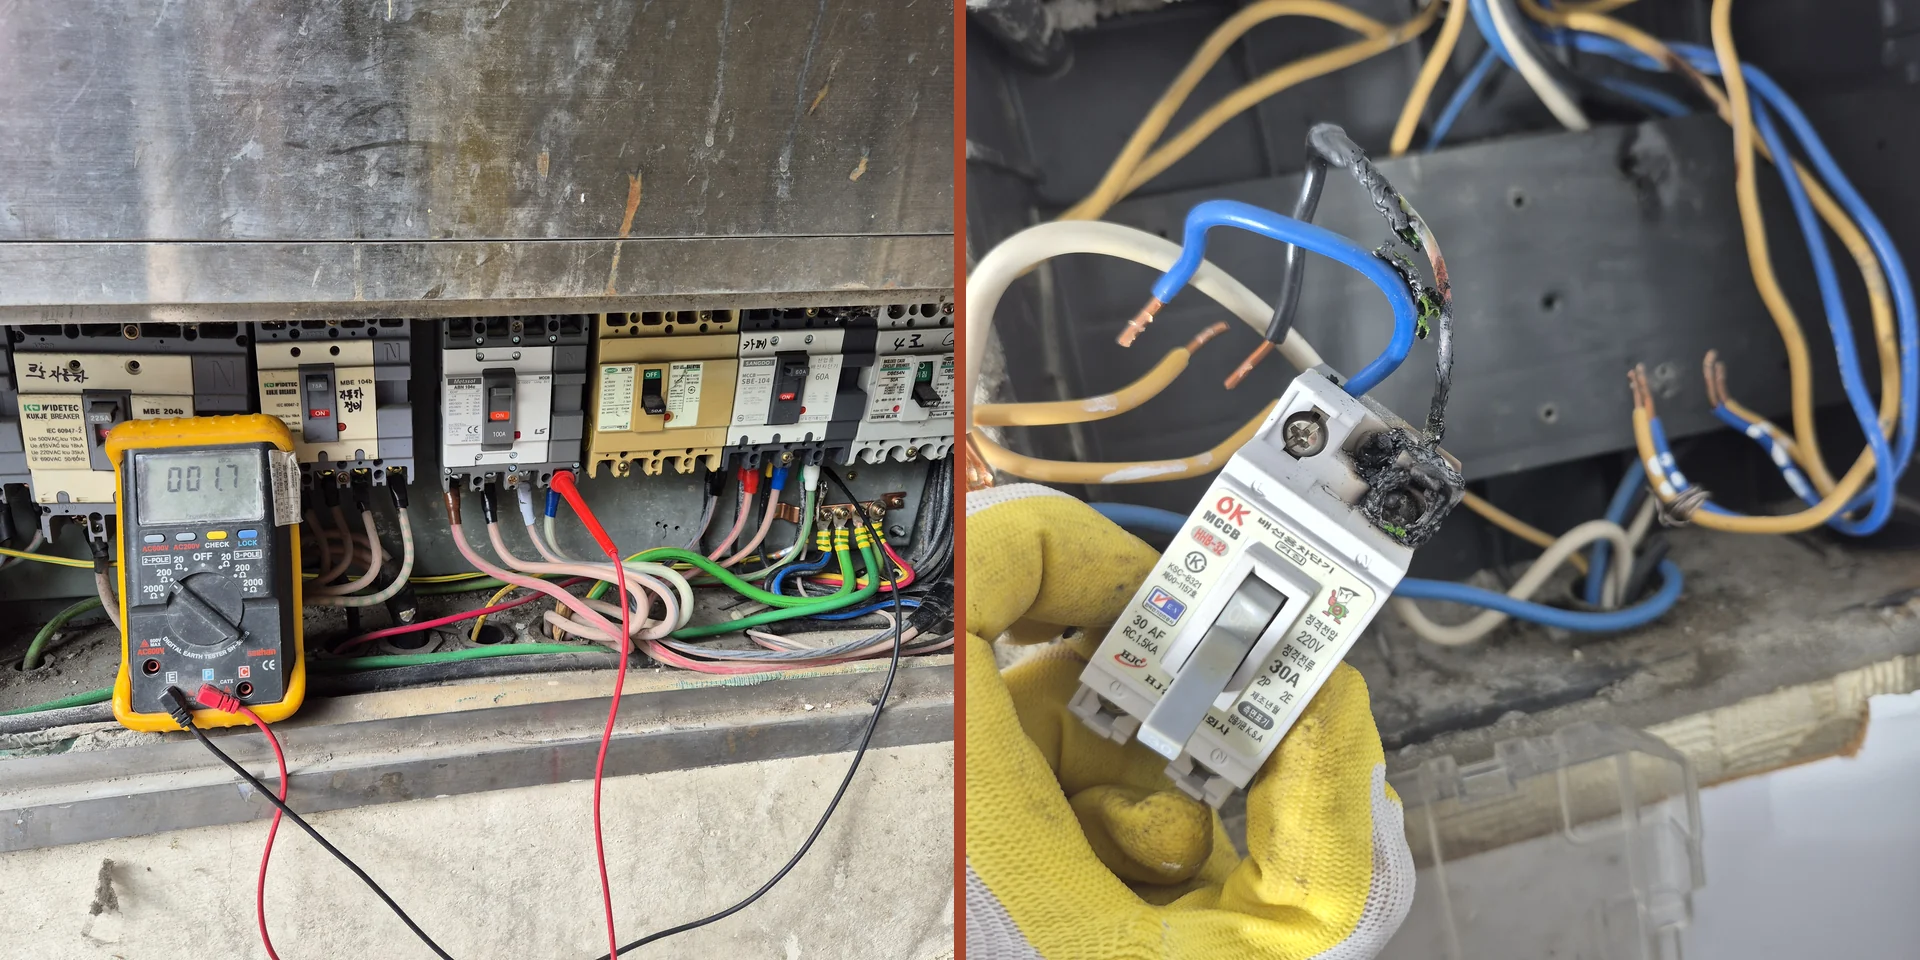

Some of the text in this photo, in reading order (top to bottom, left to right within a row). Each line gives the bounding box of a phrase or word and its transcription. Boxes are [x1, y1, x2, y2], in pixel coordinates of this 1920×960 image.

[163, 407, 184, 415] 204b
[1216, 496, 1251, 527] OK
[1202, 510, 1241, 540] MCCB
[1194, 528, 1226, 556] HHB-32
[1257, 517, 1335, 574] 배선용차단기
[193, 553, 213, 561] OFF
[1168, 562, 1202, 589] KSC-8321
[1122, 626, 1159, 655] RC.1.5KA
[1133, 615, 1166, 640] 30 AF
[1305, 614, 1338, 641] 정격전압
[163, 636, 182, 654] DIGITAL
[183, 650, 203, 659] EARTH
[204, 649, 228, 659] TESTER
[1296, 631, 1325, 653] 220V
[1120, 649, 1143, 667] HJC
[1282, 644, 1316, 672] 정격전류
[1269, 660, 1300, 688] 30A
[1250, 691, 1281, 715] 제조년월
[1257, 675, 1294, 705] 2P 2E
[1203, 713, 1230, 736] 회사
[1243, 705, 1270, 727] 측면표기
[1245, 726, 1263, 742] K.S.A
